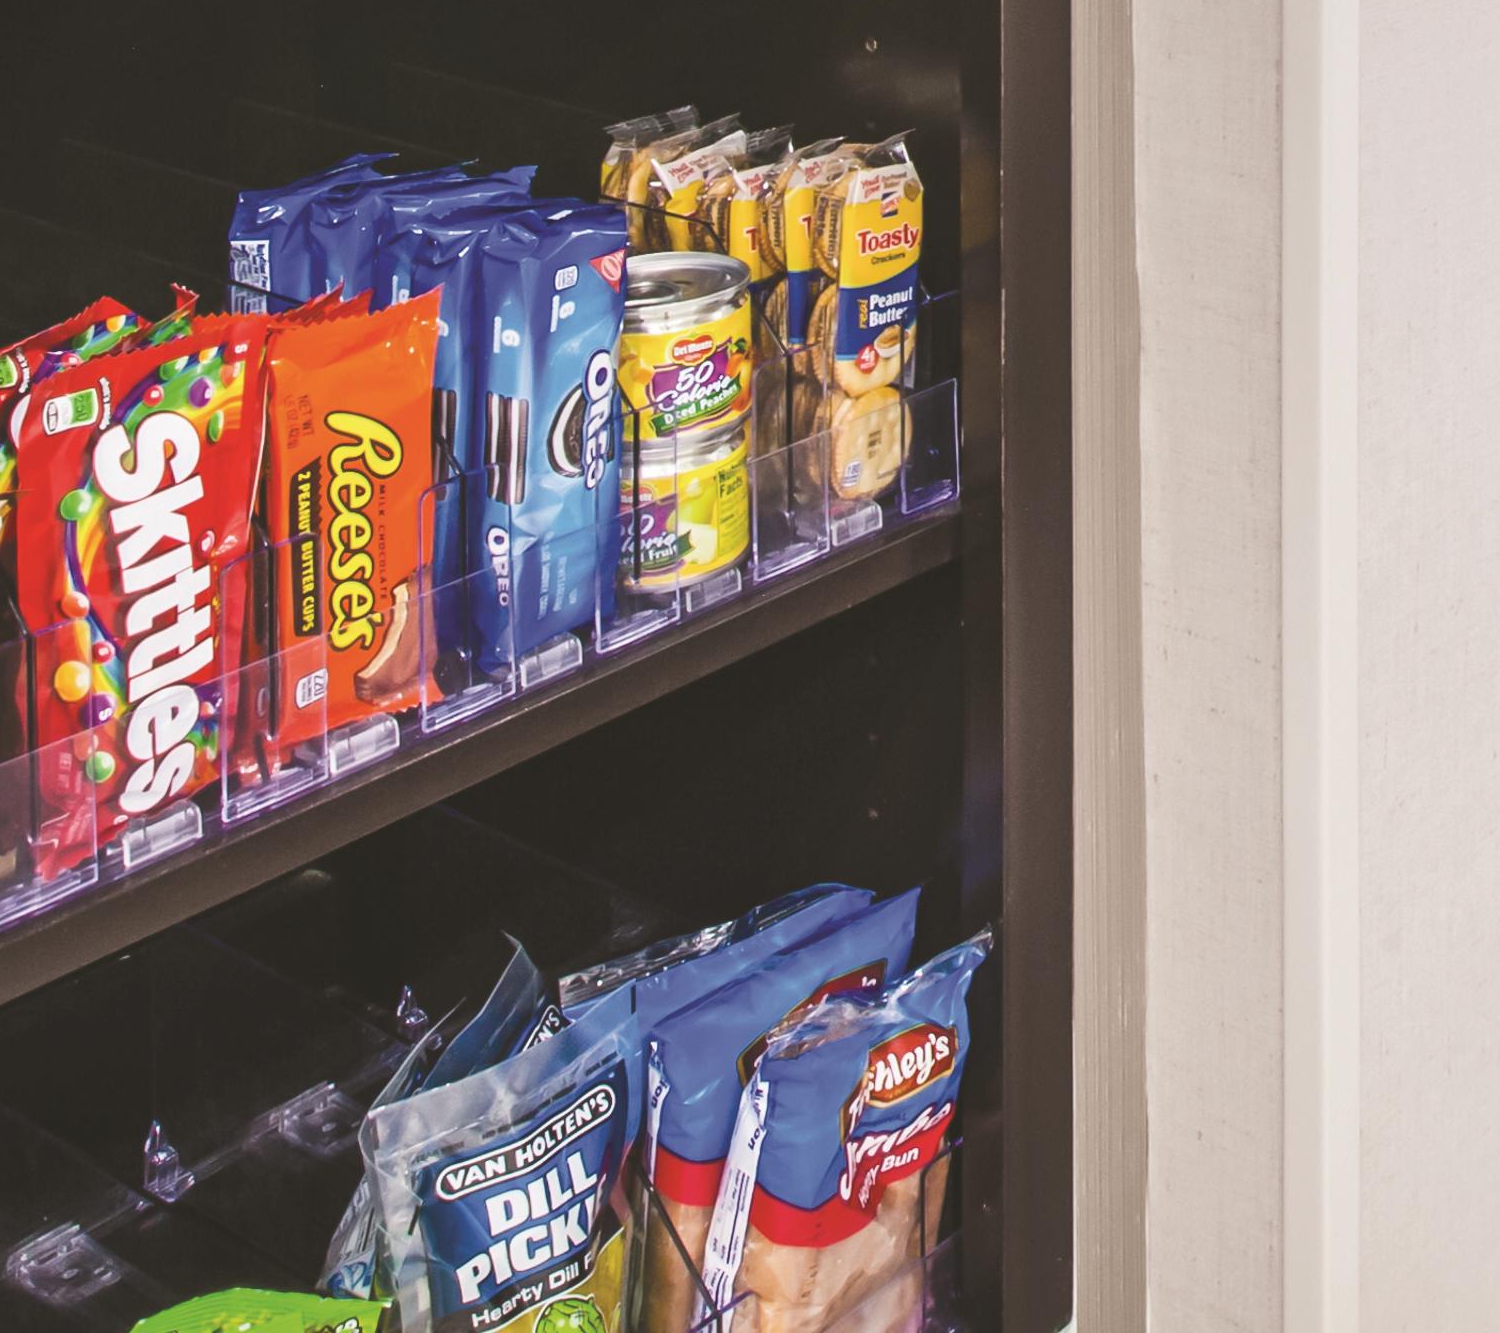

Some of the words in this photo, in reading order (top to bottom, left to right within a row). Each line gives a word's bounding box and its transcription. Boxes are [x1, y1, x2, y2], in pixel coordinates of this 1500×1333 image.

[857, 222, 920, 254] Toasty
[869, 286, 914, 311] Peanut
[675, 359, 715, 393] 50
[584, 349, 615, 491] OREO
[297, 470, 311, 482] 2
[297, 482, 312, 535] PEANUT
[322, 410, 404, 653] Reese's
[300, 539, 315, 595] BUTTER
[485, 526, 513, 608] OREO
[94, 411, 216, 816] Skittles
[301, 595, 315, 633] CUPS
[445, 1155, 507, 1191] VAN
[514, 1091, 610, 1169] HOLTEN'S
[881, 1146, 920, 1172] Bun
[485, 1150, 599, 1238] DILL
[471, 1280, 544, 1329] Hearty
[548, 1262, 580, 1291] Dill
